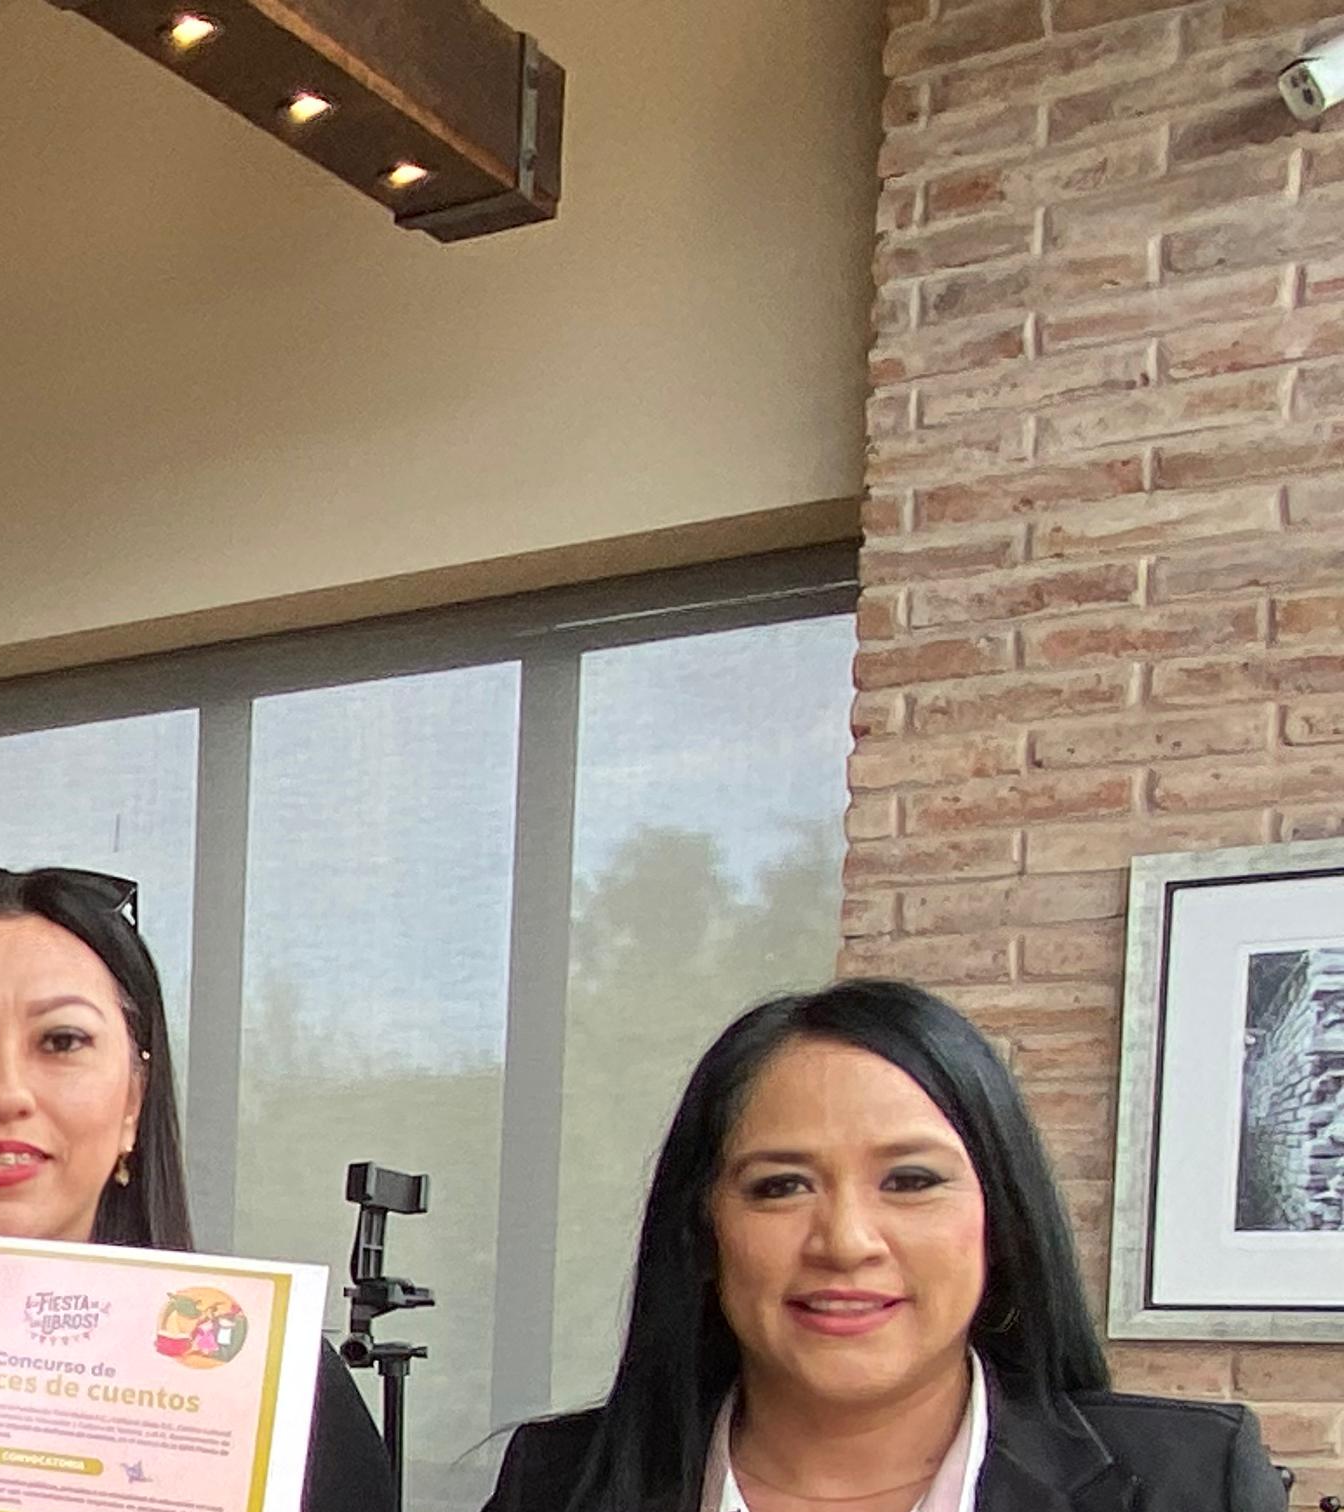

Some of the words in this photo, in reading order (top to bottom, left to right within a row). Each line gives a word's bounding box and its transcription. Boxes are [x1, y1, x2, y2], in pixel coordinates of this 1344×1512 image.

[36, 1292, 89, 1315] FIESTA
[90, 1361, 117, 1379] de
[45, 1372, 81, 1398] de
[87, 1382, 202, 1414] cuentos
